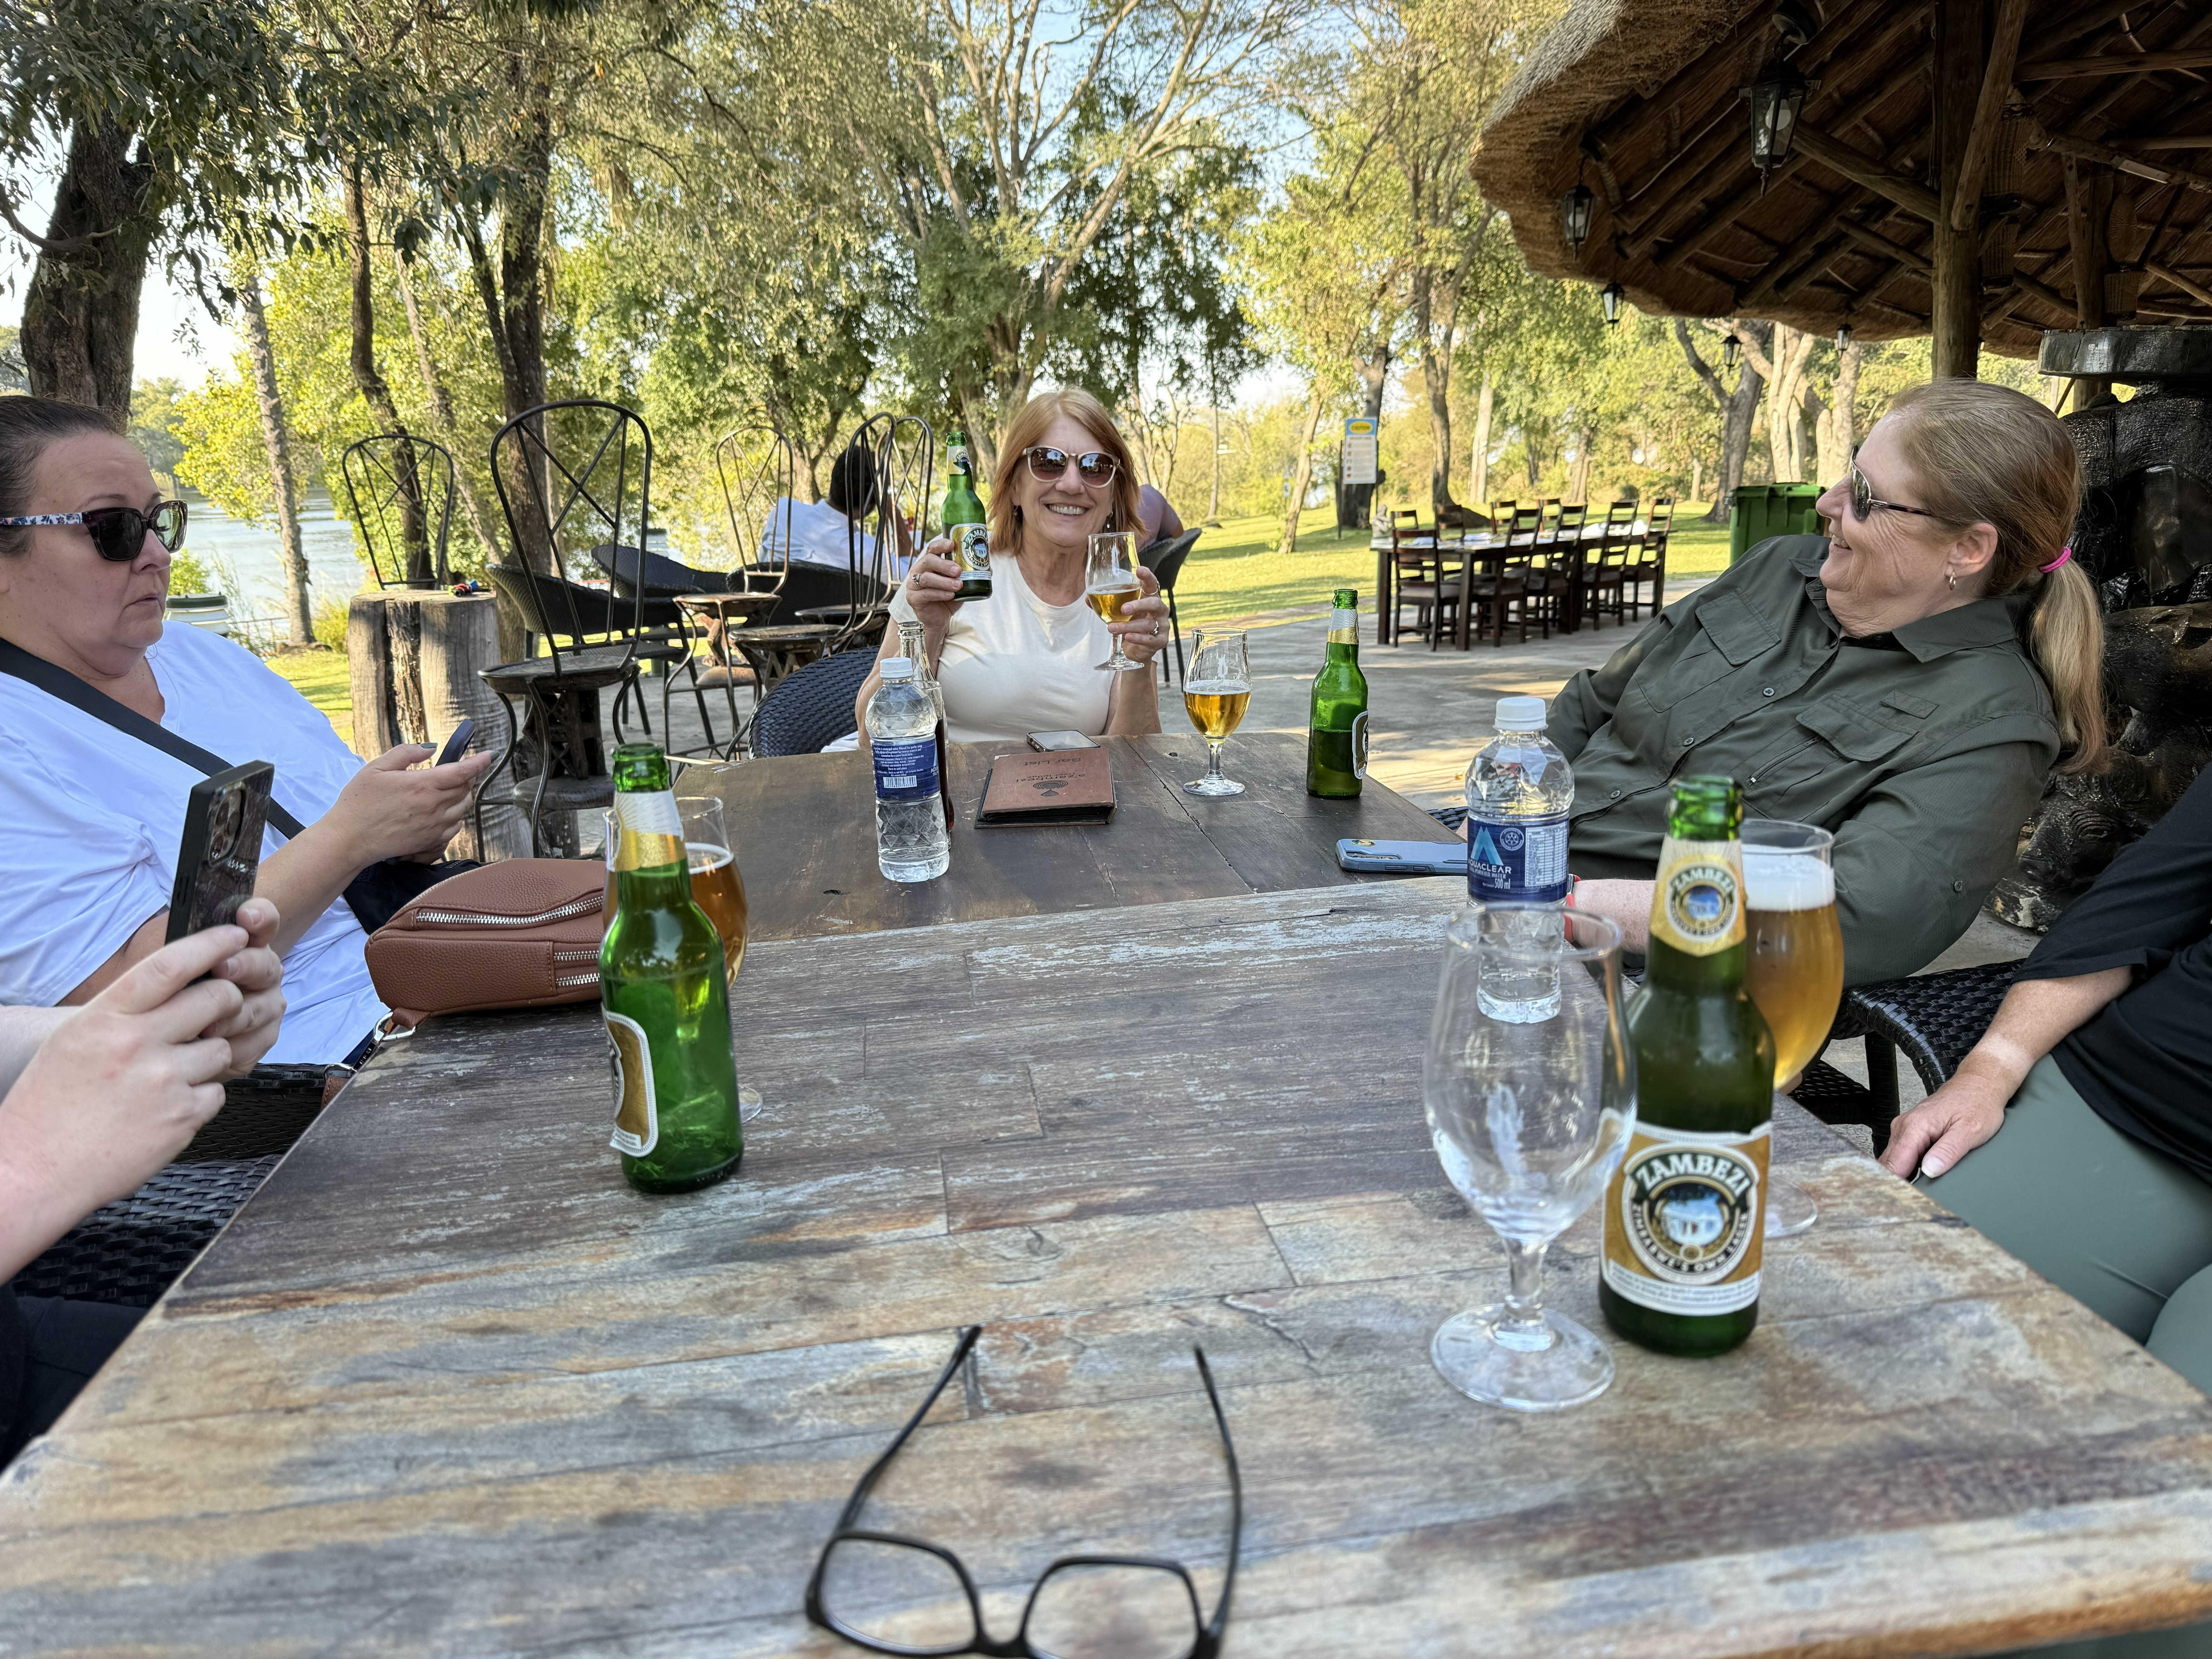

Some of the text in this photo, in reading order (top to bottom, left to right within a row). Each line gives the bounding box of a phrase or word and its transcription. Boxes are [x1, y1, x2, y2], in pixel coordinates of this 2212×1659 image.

[1494, 878, 1503, 889] 500
[1504, 878, 1510, 890] ml
[1674, 867, 1734, 892] ZAMBEZI
[1635, 1154, 1751, 1196] ZAMBEZI
[1693, 1253, 1727, 1272] OWN
